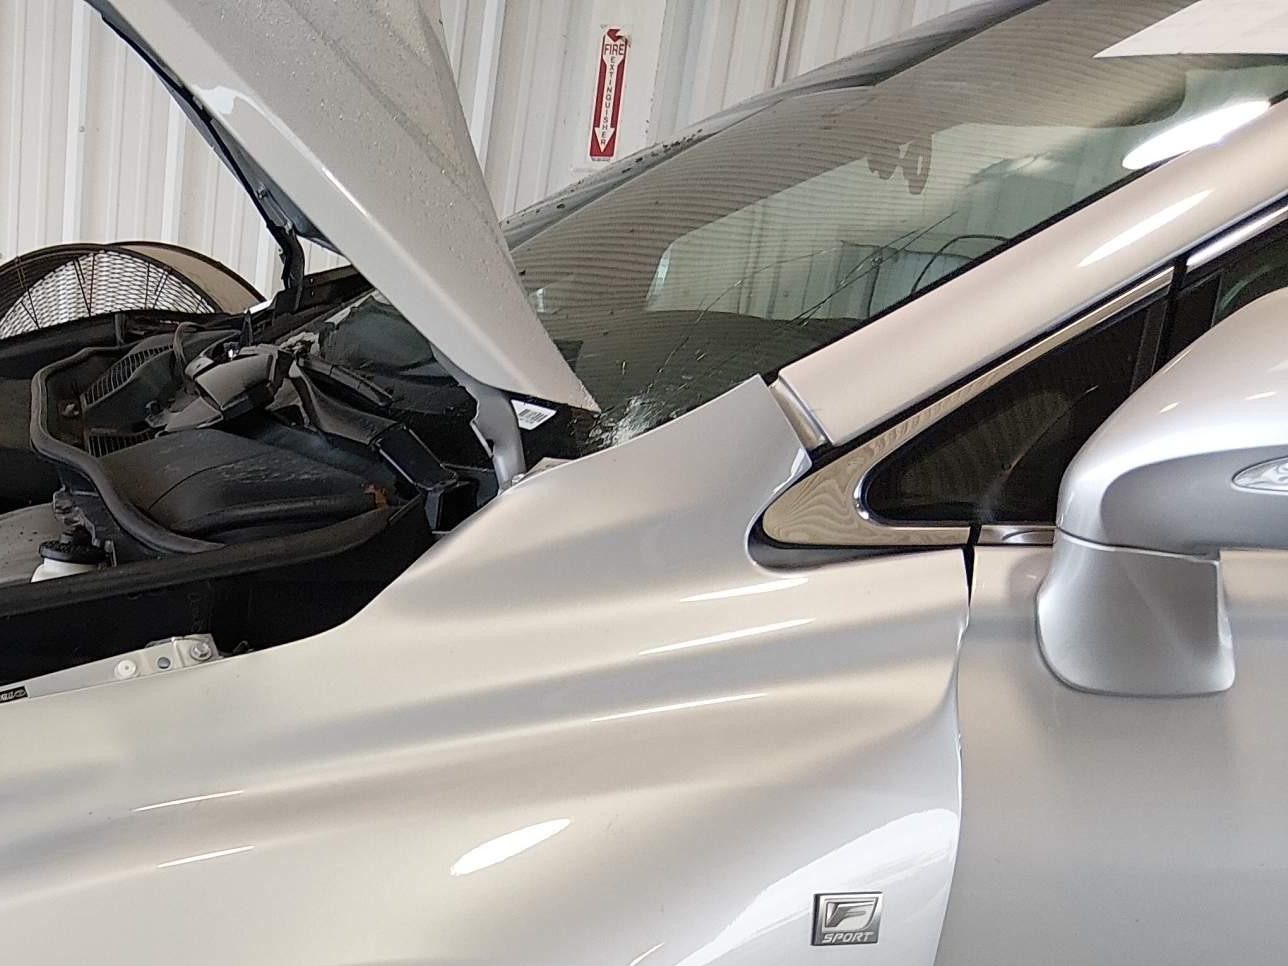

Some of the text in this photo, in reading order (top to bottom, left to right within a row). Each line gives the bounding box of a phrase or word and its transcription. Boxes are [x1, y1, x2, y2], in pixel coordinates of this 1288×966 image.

[603, 43, 625, 56] FIRE
[600, 56, 616, 146] EXTINGUISHER
[821, 931, 874, 943] SPORT
